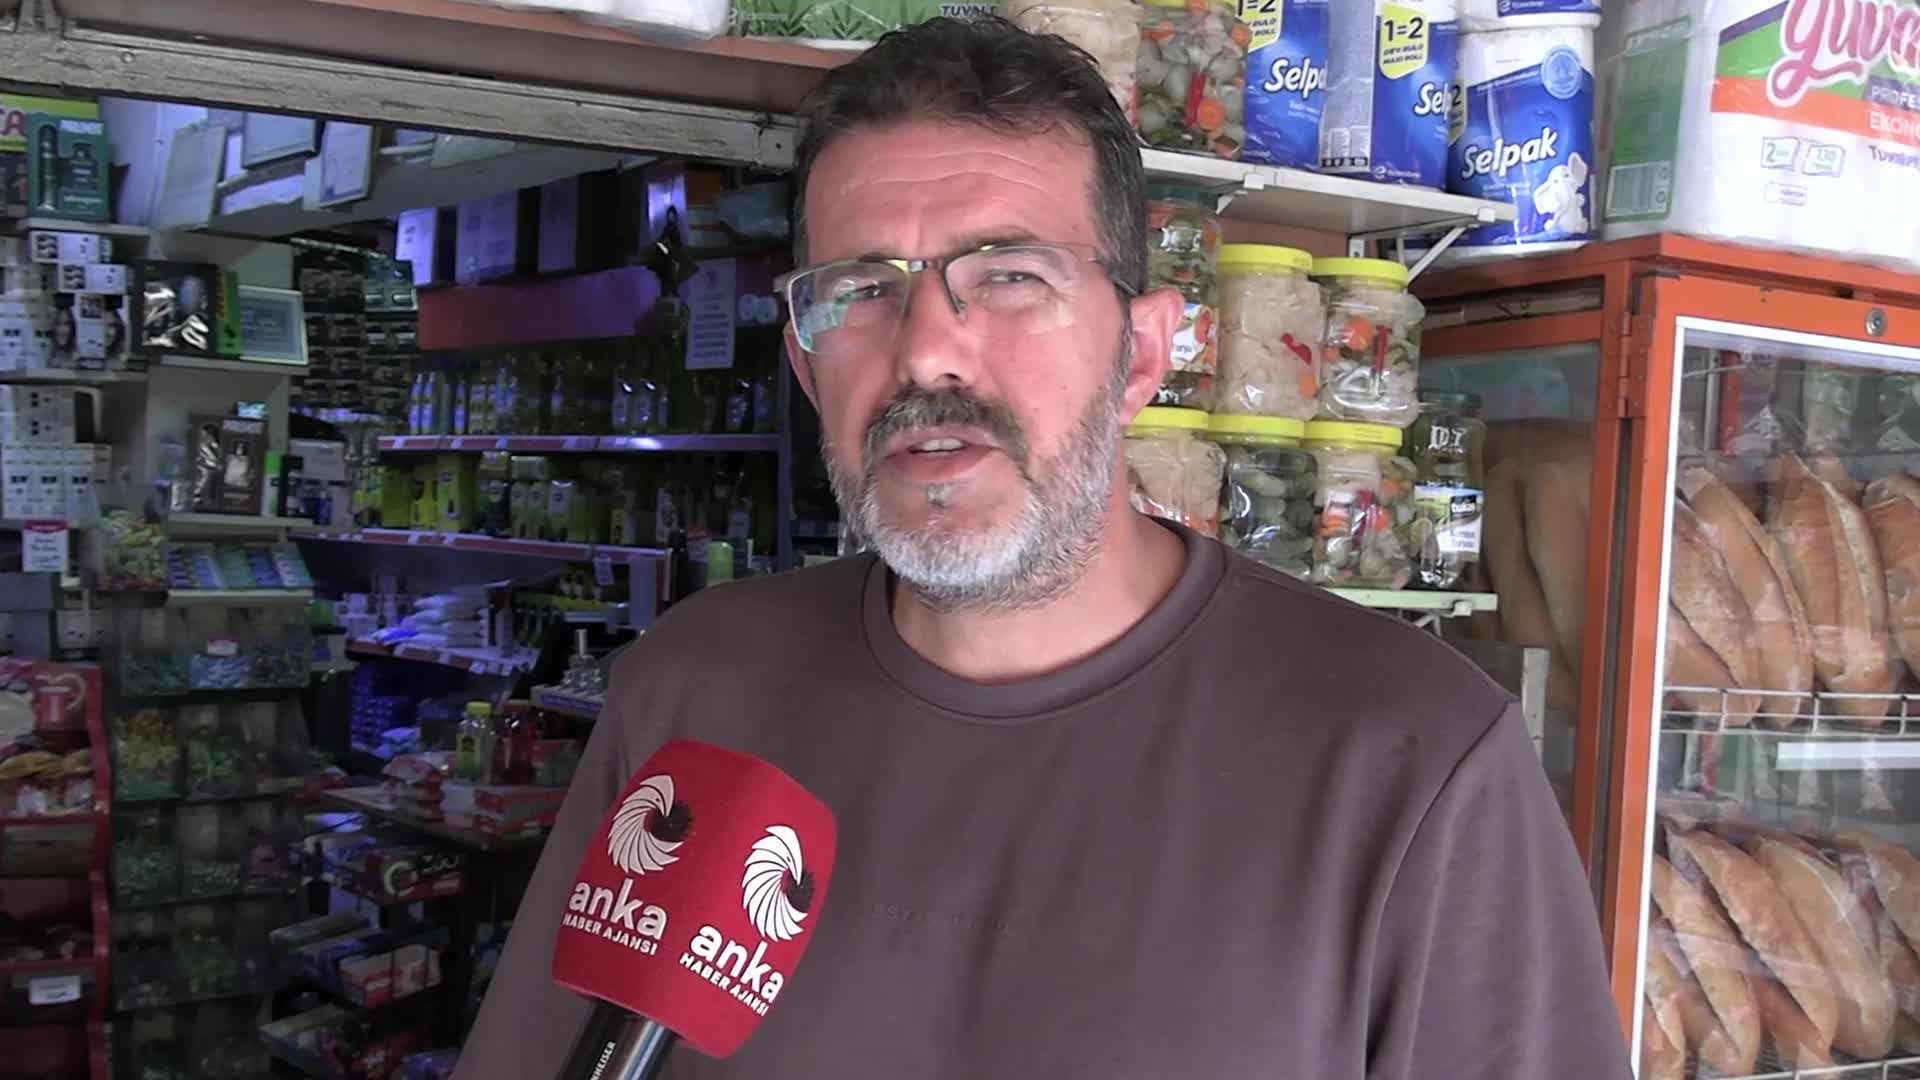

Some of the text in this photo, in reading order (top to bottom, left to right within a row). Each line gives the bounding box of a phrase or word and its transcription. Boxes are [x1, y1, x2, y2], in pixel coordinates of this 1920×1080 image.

[1384, 16, 1423, 41] 1=2
[1462, 127, 1557, 178] Selpak
[562, 913, 659, 956] HABER AJANSI
[568, 878, 668, 940] anka
[679, 952, 770, 1017] HABER AJANSI
[690, 941, 785, 1003] anka
